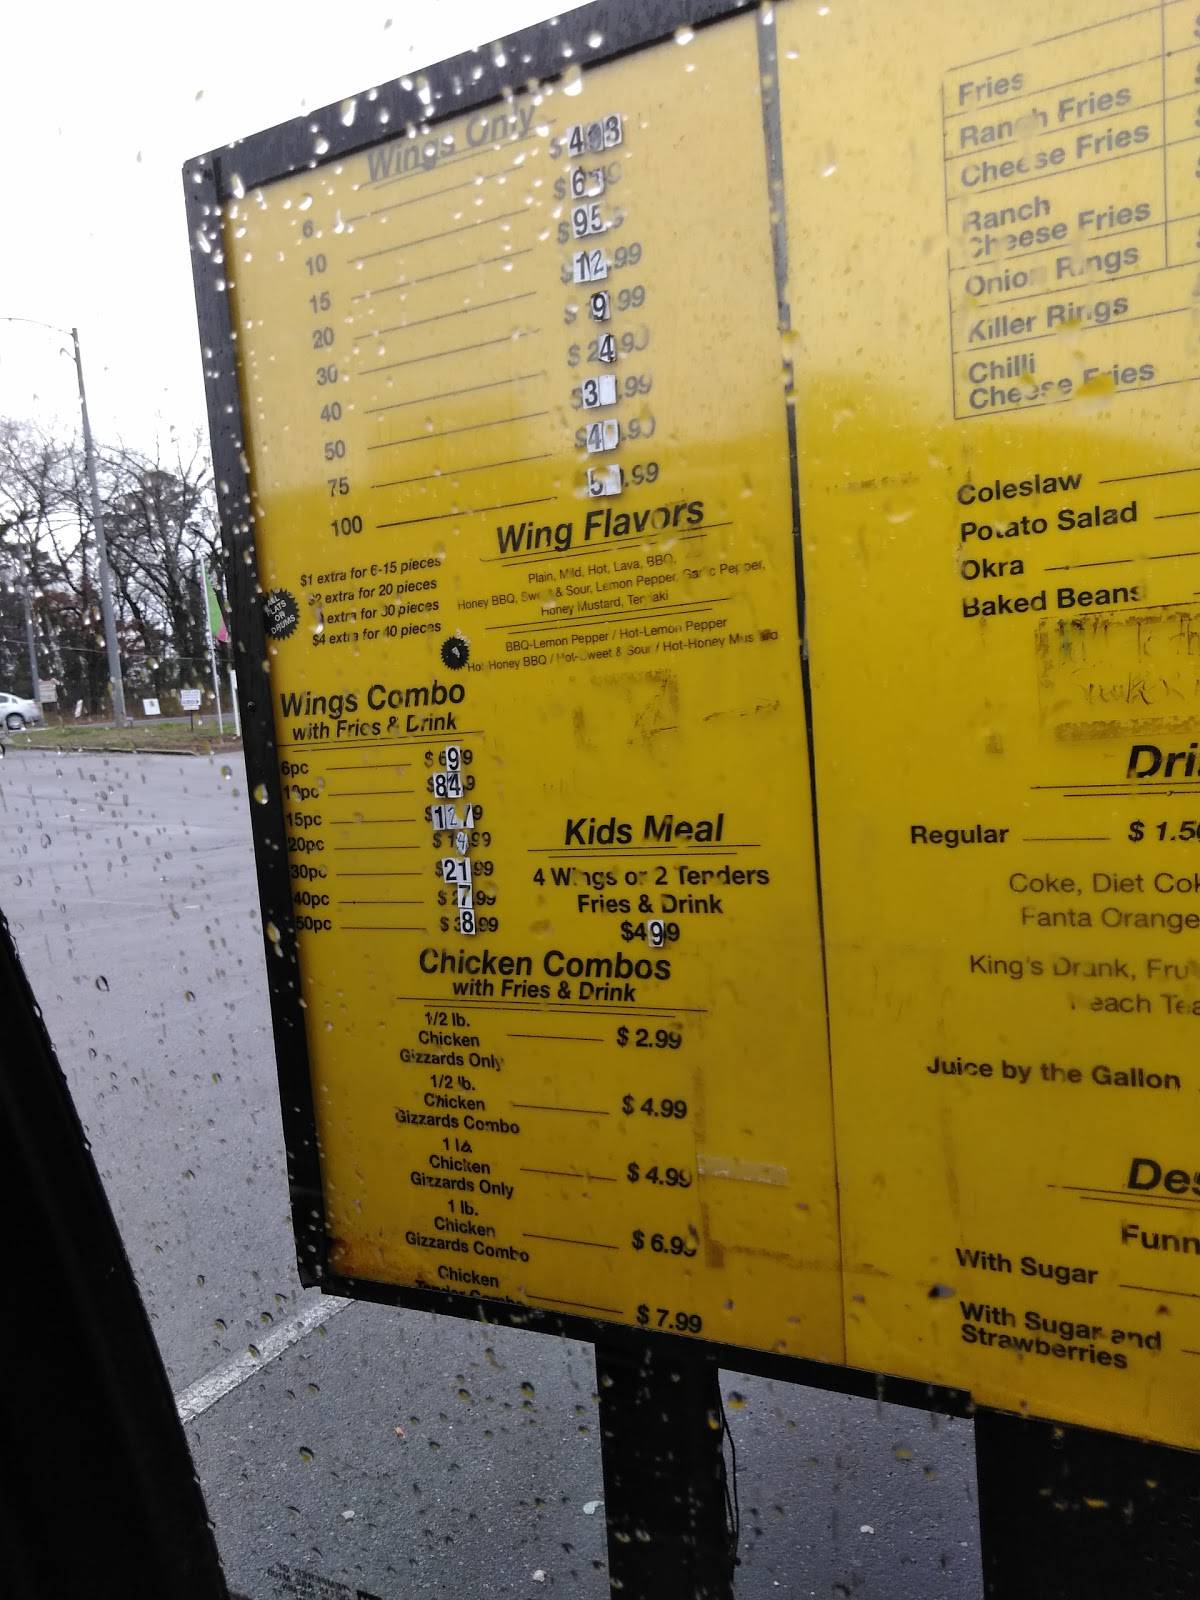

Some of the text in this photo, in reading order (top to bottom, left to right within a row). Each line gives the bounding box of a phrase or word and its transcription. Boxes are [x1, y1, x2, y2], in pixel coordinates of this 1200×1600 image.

[959, 72, 1024, 106] Fries
[960, 87, 1132, 149] Ranh Fries
[1076, 124, 1150, 159] Fries
[963, 196, 1051, 233] Ranch
[1078, 202, 1152, 231] Fries
[302, 218, 314, 238] 6
[305, 253, 327, 276] 10
[965, 266, 1040, 297] Onio
[310, 289, 332, 314] 15
[312, 325, 335, 350] 20
[968, 314, 1038, 343] Killer
[316, 363, 339, 387] 30
[968, 352, 1036, 385] Chilli
[320, 401, 343, 423] 40
[324, 439, 347, 462] 50
[327, 475, 350, 498] 75
[957, 471, 1083, 506] Coleslaw
[330, 515, 363, 538] 100
[496, 499, 705, 554] Wing Flavors
[960, 500, 1138, 543] Potato Salad
[300, 557, 442, 588] $1 extra for 6-15 pieces
[960, 558, 1025, 582] Okra
[325, 590, 355, 605] extra
[358, 587, 375, 601] for
[379, 583, 393, 597] 20
[397, 578, 438, 597] pieces
[457, 599, 489, 612] Honey
[595, 577, 633, 592] Lemon
[961, 585, 1145, 619] Baked Beans
[327, 610, 357, 625] extra
[360, 606, 377, 620] for
[399, 600, 440, 618] pieces
[541, 603, 574, 617] Honey
[362, 627, 380, 641] for
[401, 621, 442, 639] pieces
[571, 632, 609, 646] Pepper
[619, 623, 682, 639] Hot-Lemon
[686, 618, 728, 633] Pepper
[523, 654, 547, 666] BBQ
[279, 680, 466, 720] Wings Combo
[292, 721, 330, 741] with
[281, 760, 309, 777] 6pc
[1126, 742, 1200, 779] Dri
[286, 812, 322, 830] 15pc
[564, 813, 724, 846] Kids Meal
[288, 837, 325, 854] 20pc
[910, 824, 1010, 849] Regular
[291, 864, 327, 881] 30pc
[533, 867, 545, 886] 4
[655, 866, 668, 885] 2
[675, 865, 770, 885] Tenders
[1008, 872, 1083, 896] Coke,
[1092, 872, 1145, 894] Diet
[294, 891, 330, 908] 40pc
[577, 893, 724, 914] Fries & Drink
[296, 917, 331, 933] 50pc
[1021, 905, 1200, 934] Fanta Orange
[419, 948, 672, 981] Chicken Combos
[970, 954, 1044, 981] King's
[453, 979, 636, 1002] with Fries & Drink
[1070, 993, 1151, 1014] each
[424, 1011, 471, 1028] 1/2 lb.
[418, 1030, 480, 1048] Chicken
[400, 1048, 503, 1072] Gizzards Only
[430, 1074, 453, 1089] 1/2
[927, 1056, 1181, 1091] Juice by the Gallon
[423, 1093, 486, 1111] Chicken
[395, 1109, 520, 1135] Gizzards Combo
[428, 1155, 491, 1175] Chicken
[410, 1171, 514, 1200] Gizzards Only
[447, 1200, 479, 1216] 1 lb.
[433, 1216, 496, 1239] Chicken
[405, 1231, 469, 1254] Gizzards
[438, 1265, 499, 1288] Chicken
[955, 1247, 1099, 1286] With Sugar
[959, 1301, 1016, 1328] With
[1024, 1311, 1103, 1341] Sugar
[961, 1323, 1129, 1369] Strawberries
